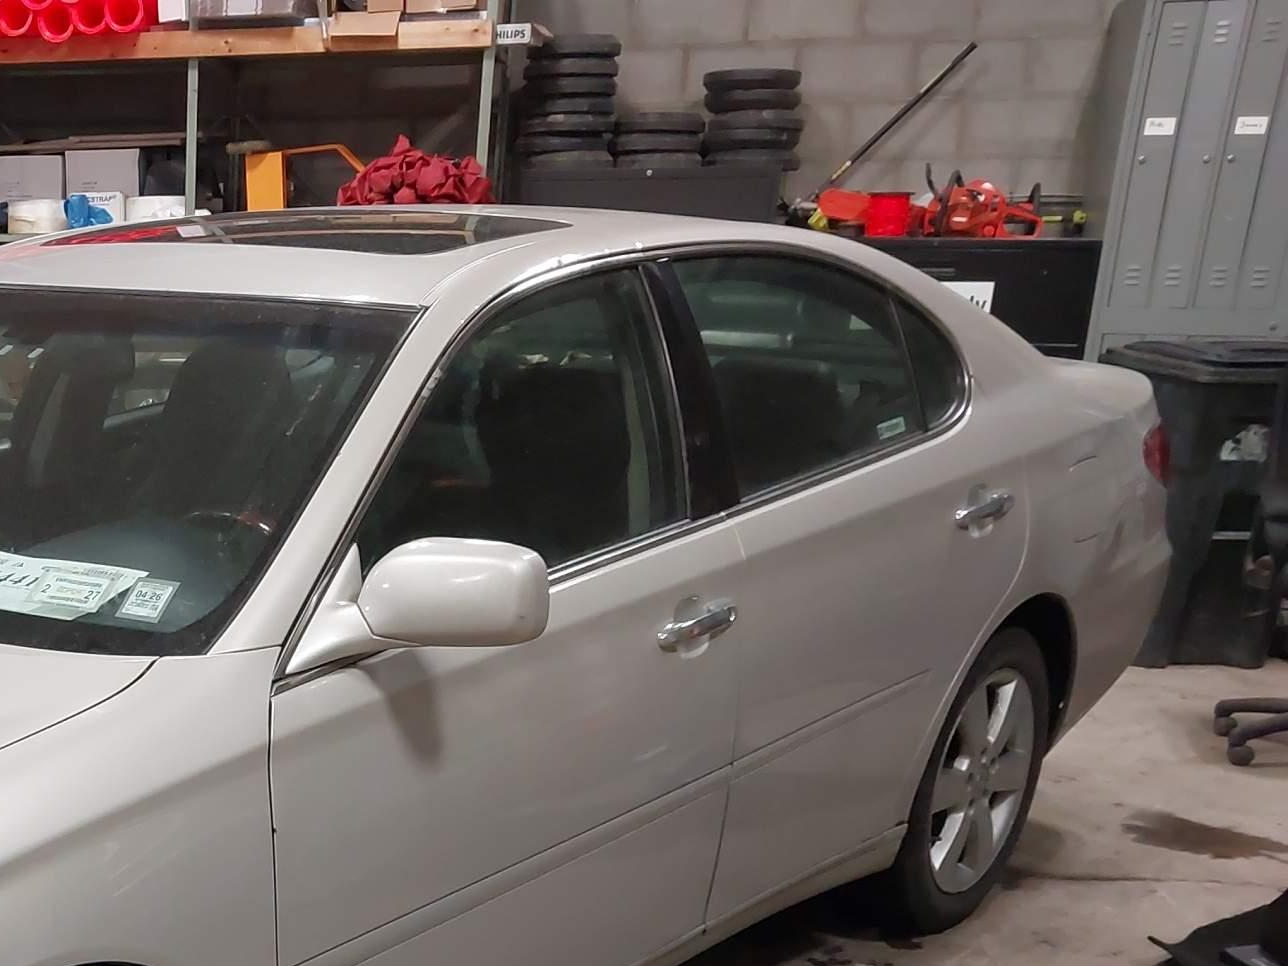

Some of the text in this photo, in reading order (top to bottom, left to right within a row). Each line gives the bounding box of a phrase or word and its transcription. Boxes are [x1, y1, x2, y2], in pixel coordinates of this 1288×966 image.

[496, 28, 527, 40] HILIPS
[40, 583, 52, 594] 2
[83, 590, 101, 601] 27
